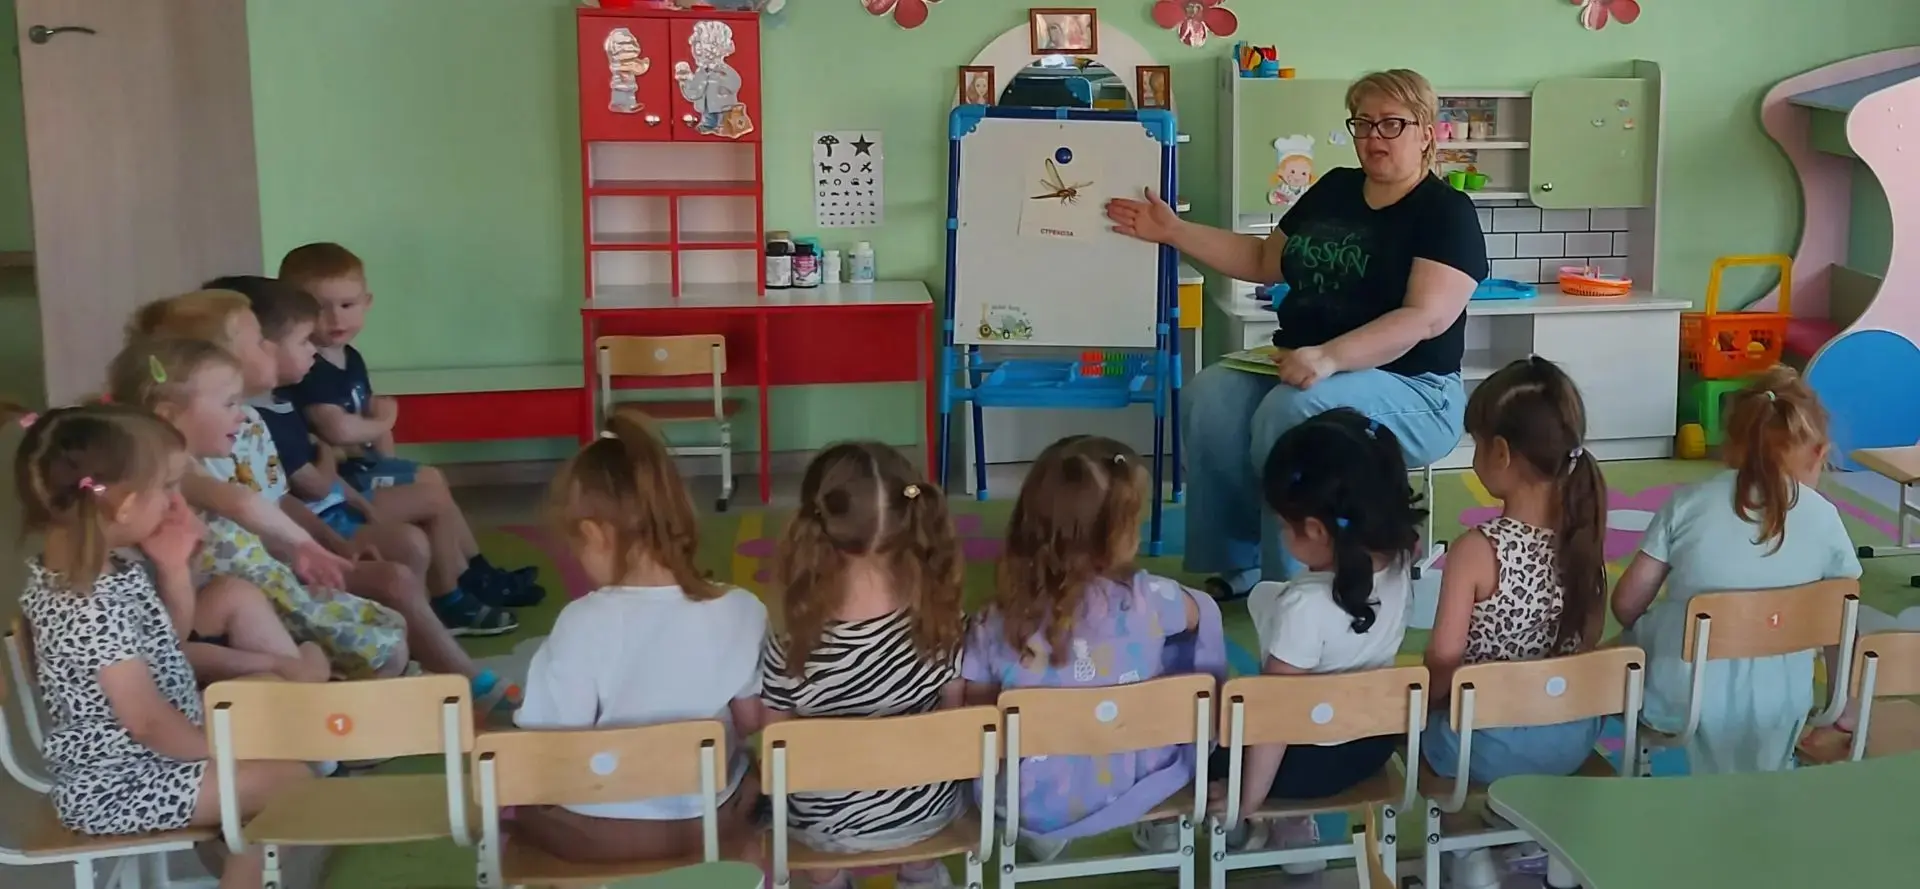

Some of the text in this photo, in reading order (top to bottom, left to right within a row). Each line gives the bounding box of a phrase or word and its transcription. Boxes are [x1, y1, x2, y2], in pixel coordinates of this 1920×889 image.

[1040, 228, 1074, 237] СТРЕКОЗА
[1284, 232, 1371, 278] PASSION
[1771, 614, 1778, 625] 1
[334, 718, 343, 731] 1
